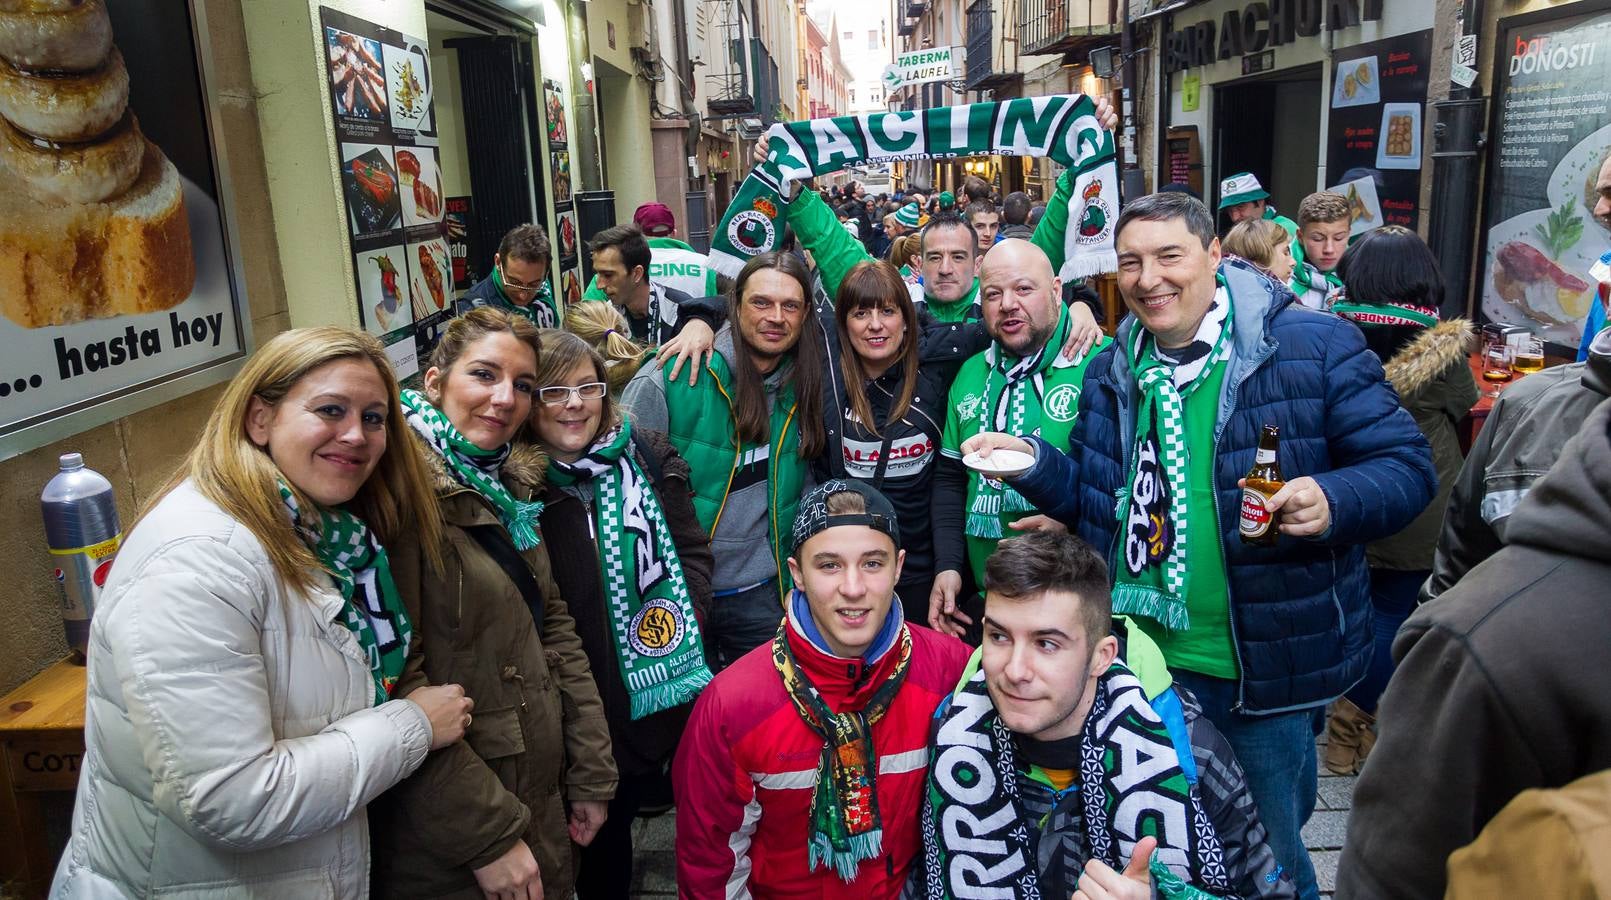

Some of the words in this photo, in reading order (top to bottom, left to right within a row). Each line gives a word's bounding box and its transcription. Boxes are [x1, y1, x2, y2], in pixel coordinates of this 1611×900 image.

[898, 50, 950, 67] TABERNA
[1166, 20, 1216, 72] BAR
[1509, 42, 1596, 76] DONOSTI
[906, 65, 949, 81] LAUREL
[767, 93, 1105, 182] RACING
[449, 241, 467, 258] ato
[648, 263, 701, 277] CING
[54, 325, 162, 380] hasta
[169, 311, 223, 349] hoy
[843, 438, 933, 463] ALACIOS
